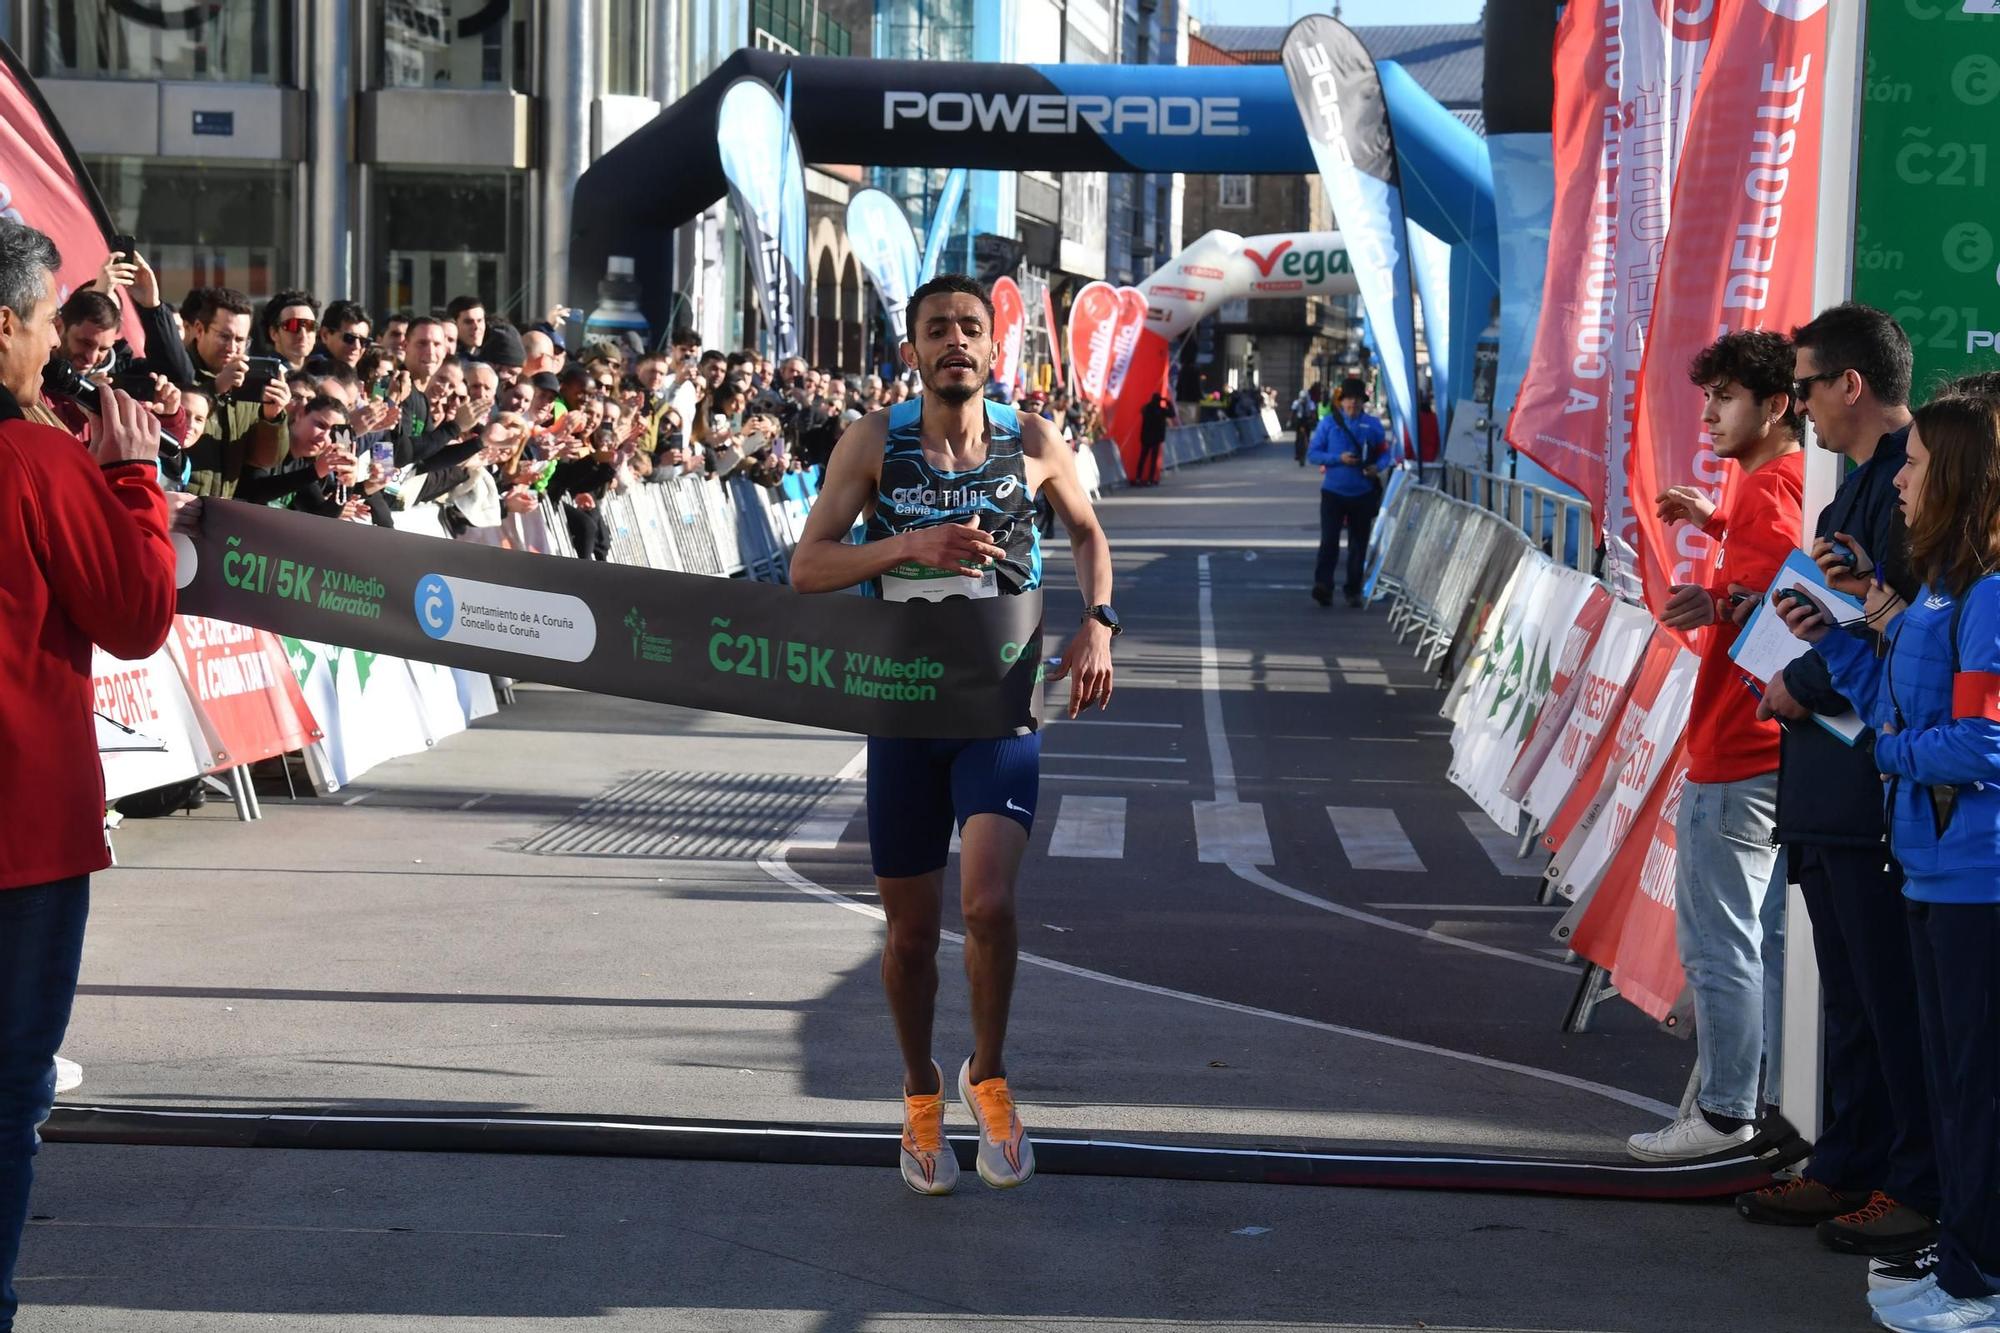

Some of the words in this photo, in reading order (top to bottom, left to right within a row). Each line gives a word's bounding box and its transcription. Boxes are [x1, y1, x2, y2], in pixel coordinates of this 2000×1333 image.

[884, 91, 1240, 136] POWERADE
[1244, 240, 1354, 285] Vega
[892, 484, 936, 506] ada
[943, 486, 987, 507] TRIBE
[322, 569, 341, 589] XV
[343, 574, 385, 599] Medio
[317, 590, 381, 619] Maratón
[460, 601, 519, 622] Ayuntamiento
[520, 610, 532, 624] de
[533, 613, 541, 625] A
[542, 615, 574, 630] Coruña
[460, 616, 496, 634] Concello
[497, 621, 508, 635] da
[510, 624, 540, 639] Coruña
[844, 651, 872, 674] XV
[873, 655, 945, 681] Medio
[93, 668, 159, 726] EPORTE
[844, 673, 936, 701] Maratón
